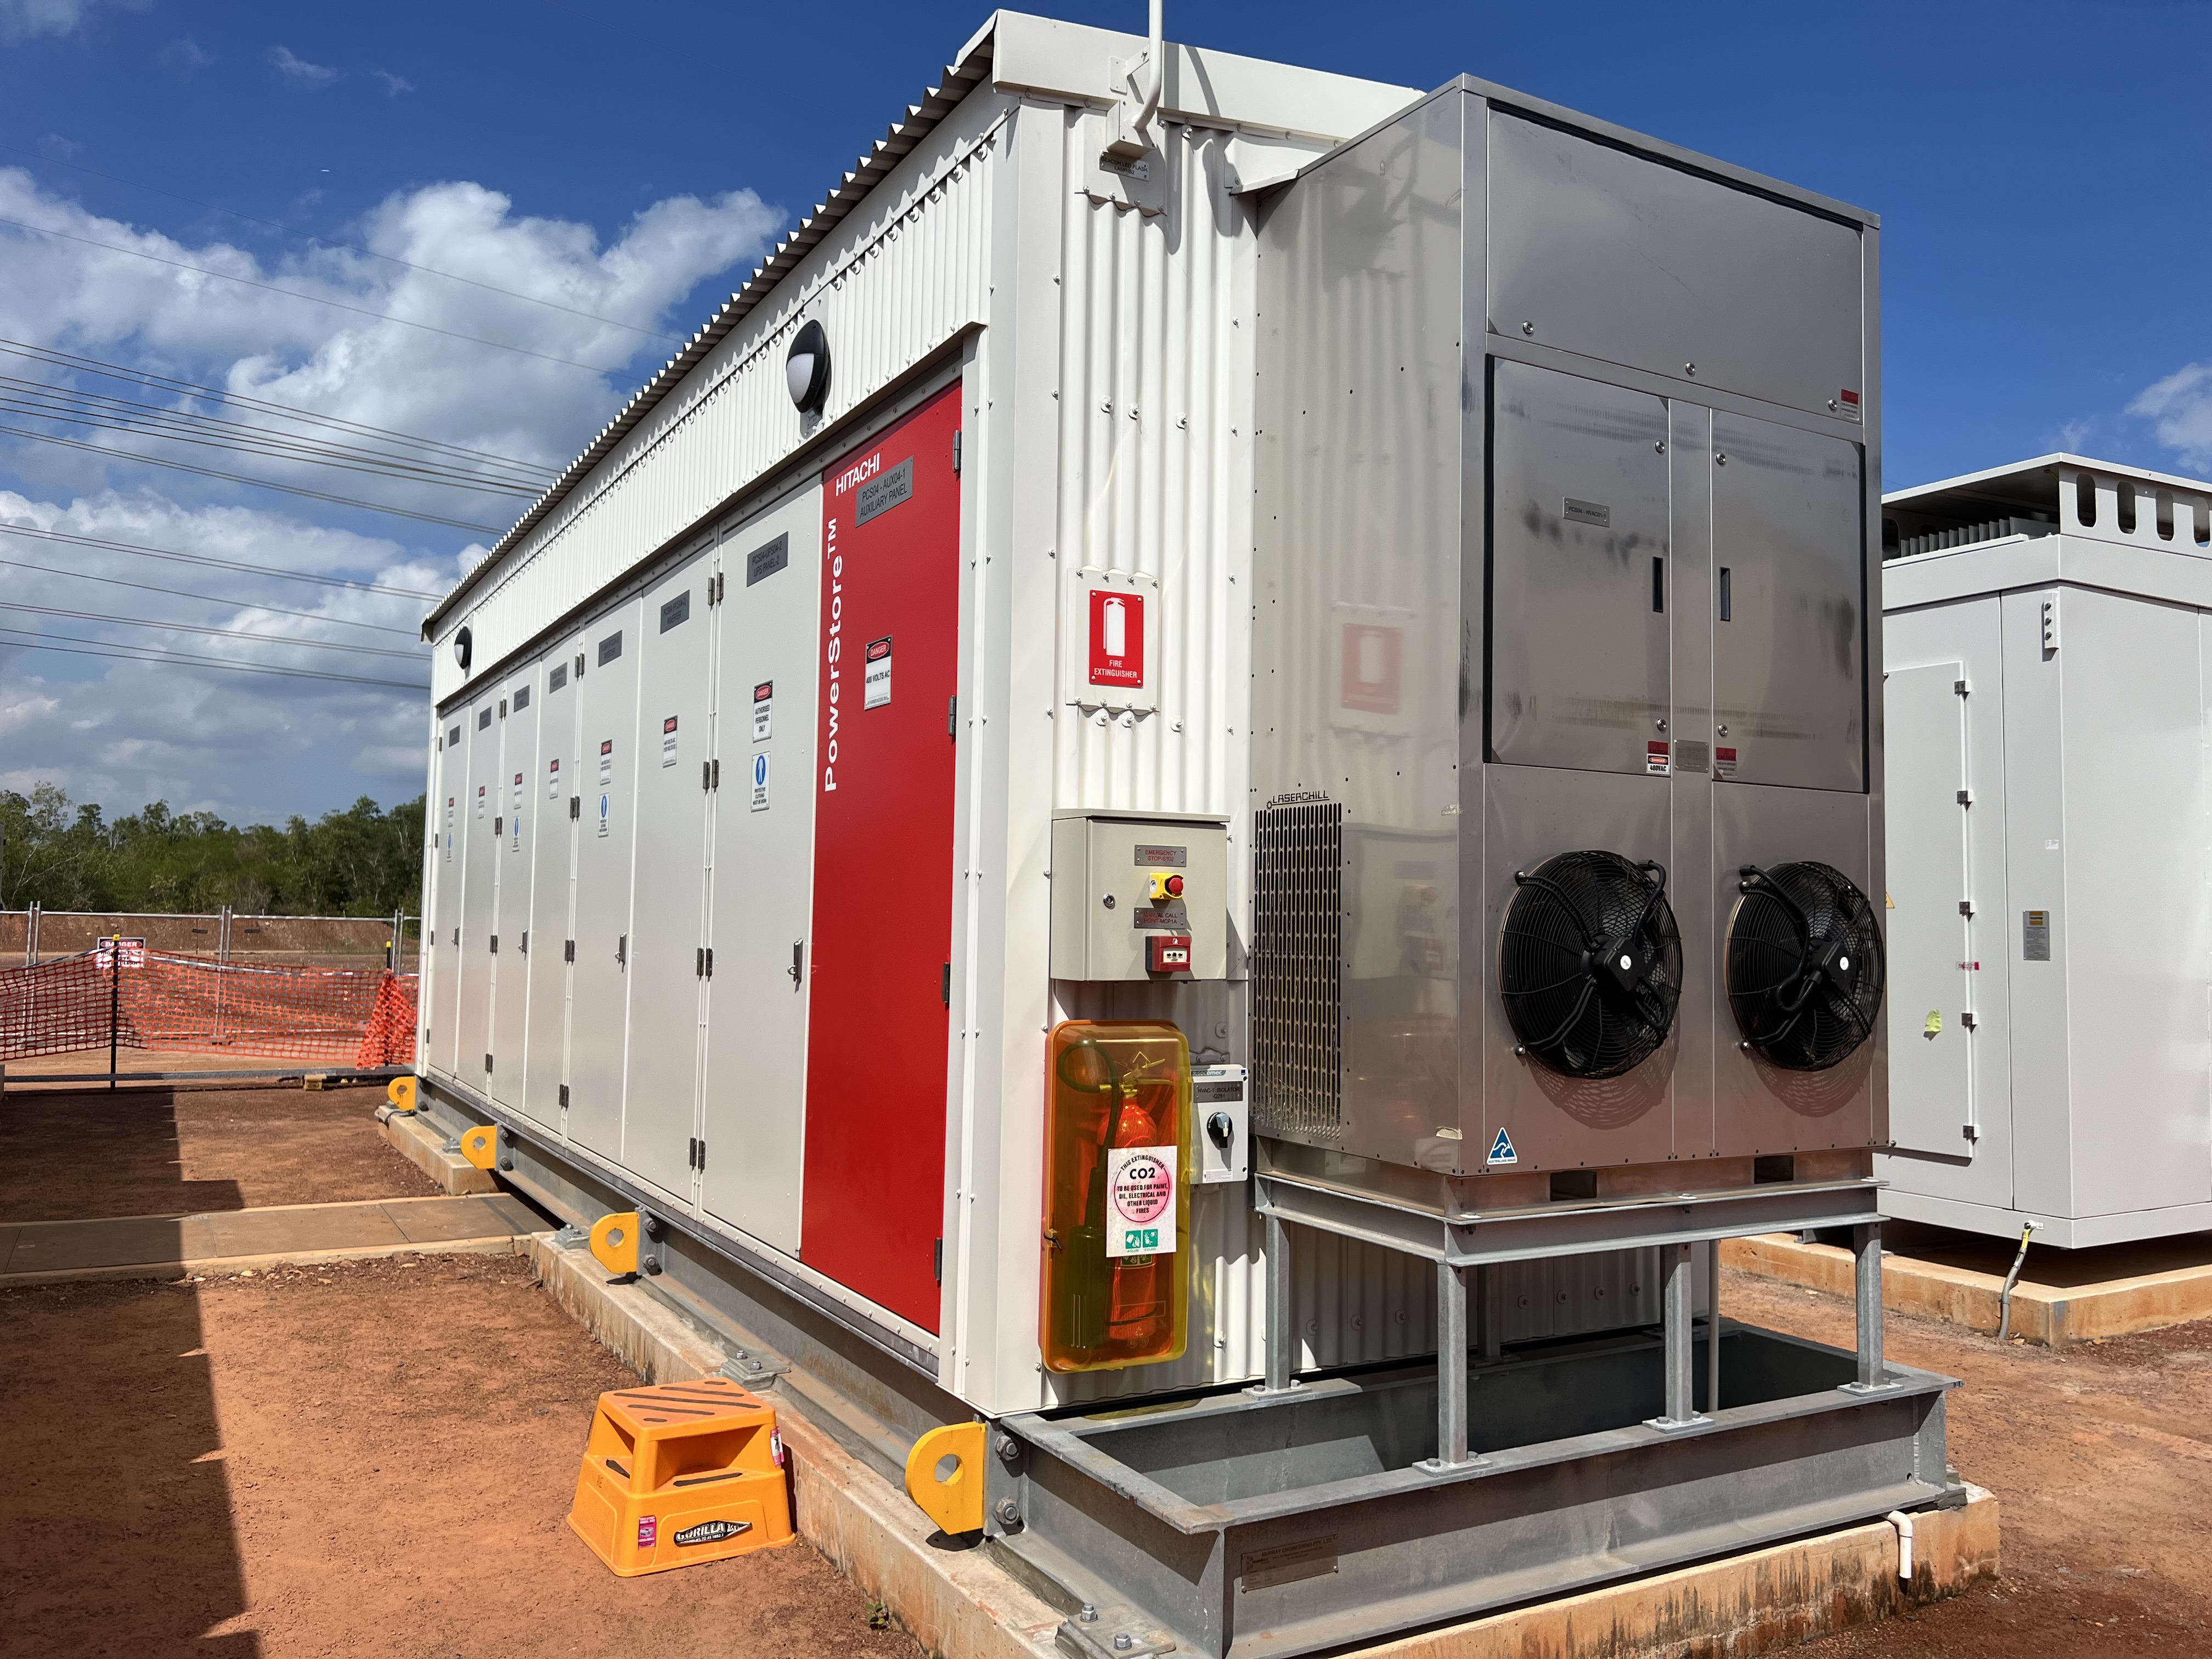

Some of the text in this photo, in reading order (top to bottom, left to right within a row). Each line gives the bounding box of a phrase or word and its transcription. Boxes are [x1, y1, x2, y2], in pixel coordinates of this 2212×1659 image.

[1101, 156, 1121, 166] BEACON
[836, 452, 880, 496] HITACHI
[862, 483, 879, 503] PCS04
[883, 467, 906, 491] AUX04-1
[860, 482, 907, 519] AUXILIARY PANEL
[754, 565, 763, 577] UPS
[870, 644, 887, 657] DANGER
[1109, 659, 1122, 668] FIRE
[872, 672, 884, 682] VOLTS
[885, 669, 890, 678] AC
[1094, 668, 1138, 679] EXTINGUISHER
[1272, 790, 1329, 804] LASERCHILL
[1120, 1154, 1164, 1171] THIS EXTINGUISHER
[1130, 1167, 1155, 1180] CO2
[676, 1522, 725, 1541] GORILLA
[1262, 1549, 1280, 1557] MURRAY
[1282, 1543, 1312, 1553] ENGINEERING
